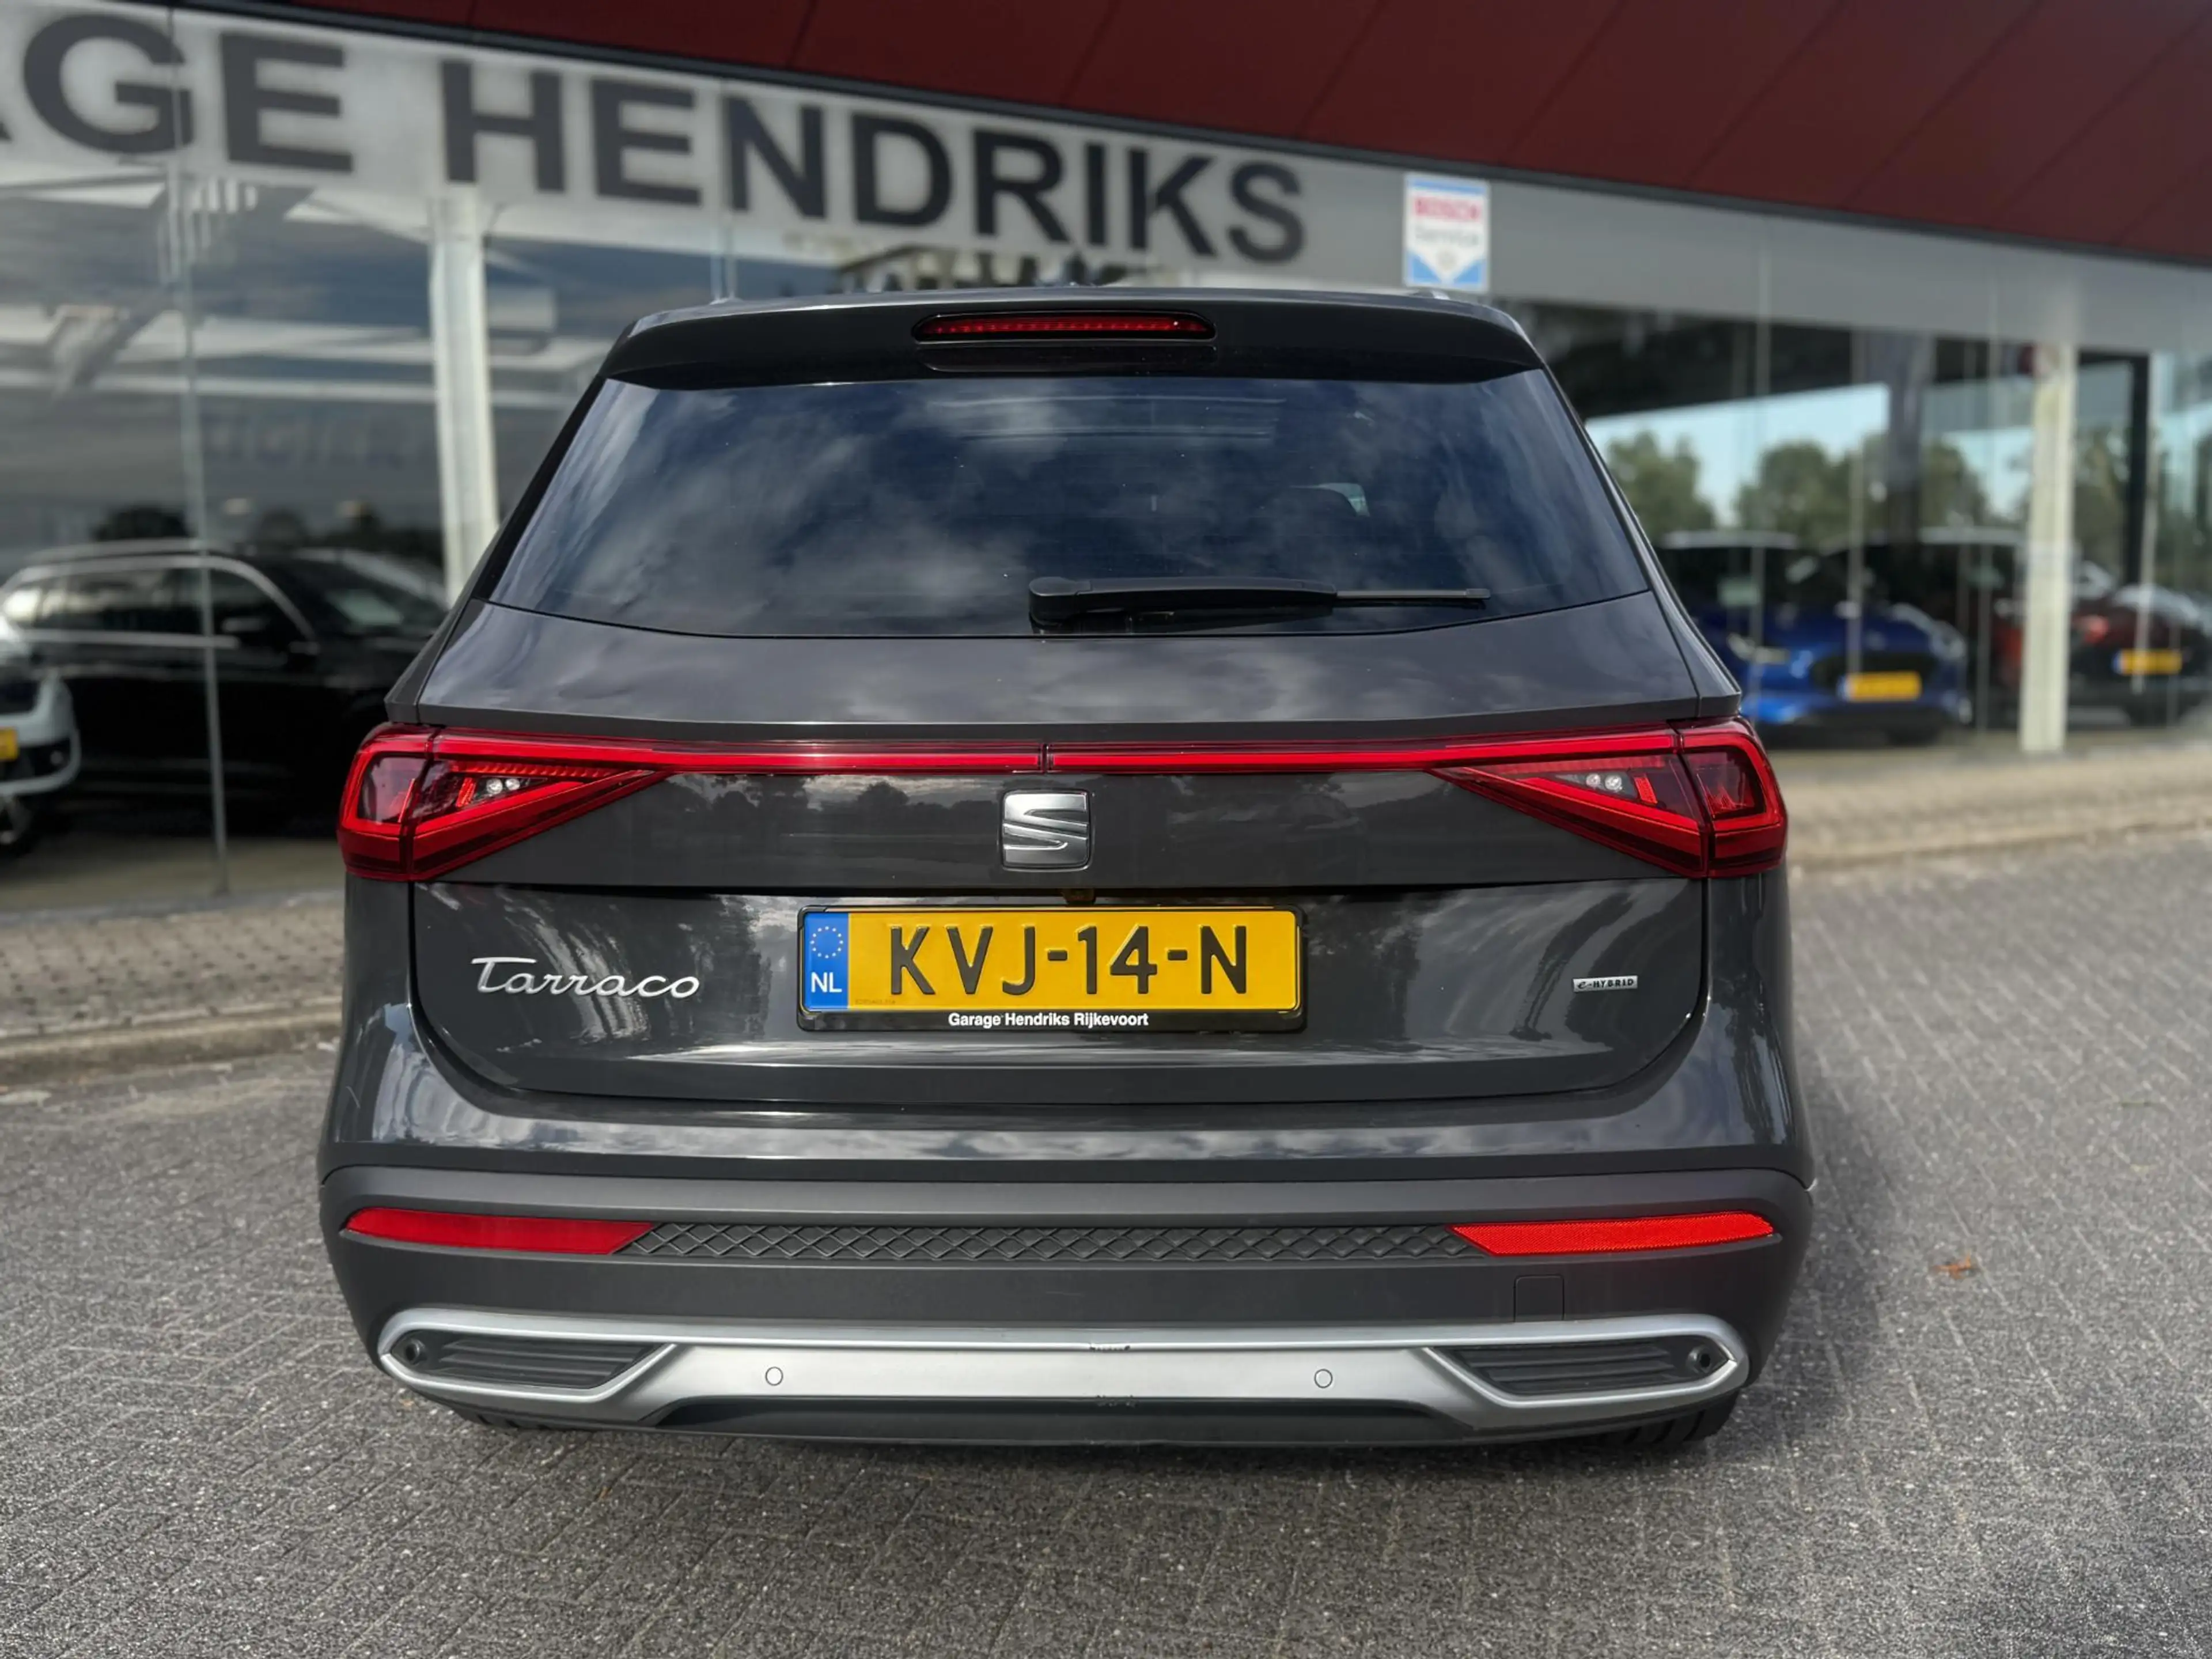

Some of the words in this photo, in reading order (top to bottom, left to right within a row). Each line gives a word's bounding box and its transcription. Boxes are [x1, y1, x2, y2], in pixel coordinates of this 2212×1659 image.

[0, 14, 353, 173] GE
[440, 59, 1305, 263] HENDRIKS
[889, 925, 1247, 995] KVJ-14-N
[471, 957, 700, 998] Tarraco
[810, 972, 842, 993] NL
[1577, 979, 1634, 989] e-HYBRID
[948, 1013, 1001, 1029] Garage
[1005, 1013, 1070, 1026] Hendriks
[1074, 1013, 1149, 1029] Rijkevoort
